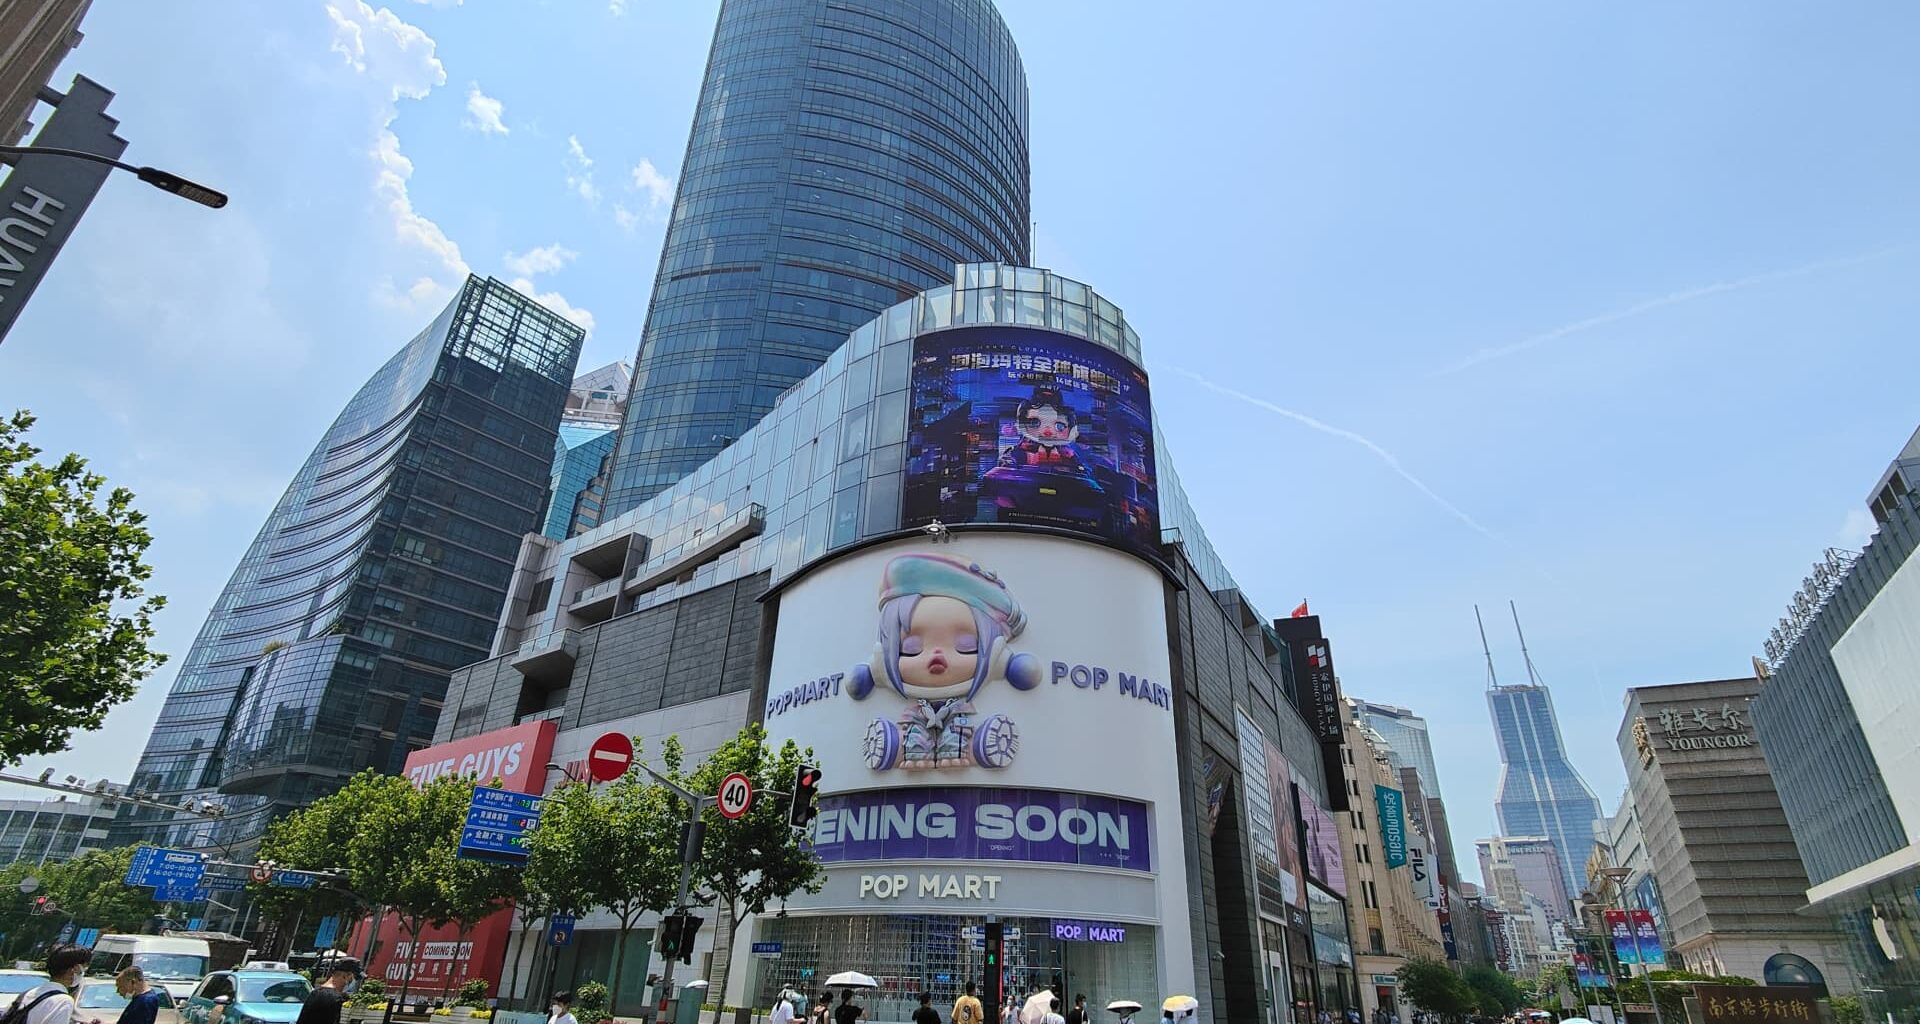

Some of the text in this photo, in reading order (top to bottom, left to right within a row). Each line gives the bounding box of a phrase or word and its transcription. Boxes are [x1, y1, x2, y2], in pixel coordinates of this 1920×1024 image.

[767, 672, 844, 720] POP MART
[1051, 660, 1171, 711] POP MART
[1317, 708, 1327, 737] PLAZA
[1659, 703, 1745, 737] 雅戈尔
[1667, 733, 1753, 752] YOUNGOR
[408, 742, 524, 791] FIVE GUYS
[724, 784, 746, 807] 40
[808, 803, 1130, 850] ENING SOON
[1410, 848, 1427, 882] FILA
[859, 874, 1002, 899] POP MART
[1055, 924, 1125, 942] POP MART
[424, 945, 449, 956] COMING
[450, 945, 472, 956] SON
[385, 962, 417, 980] GUYS
[1709, 997, 1809, 1021] 南京路步行街
